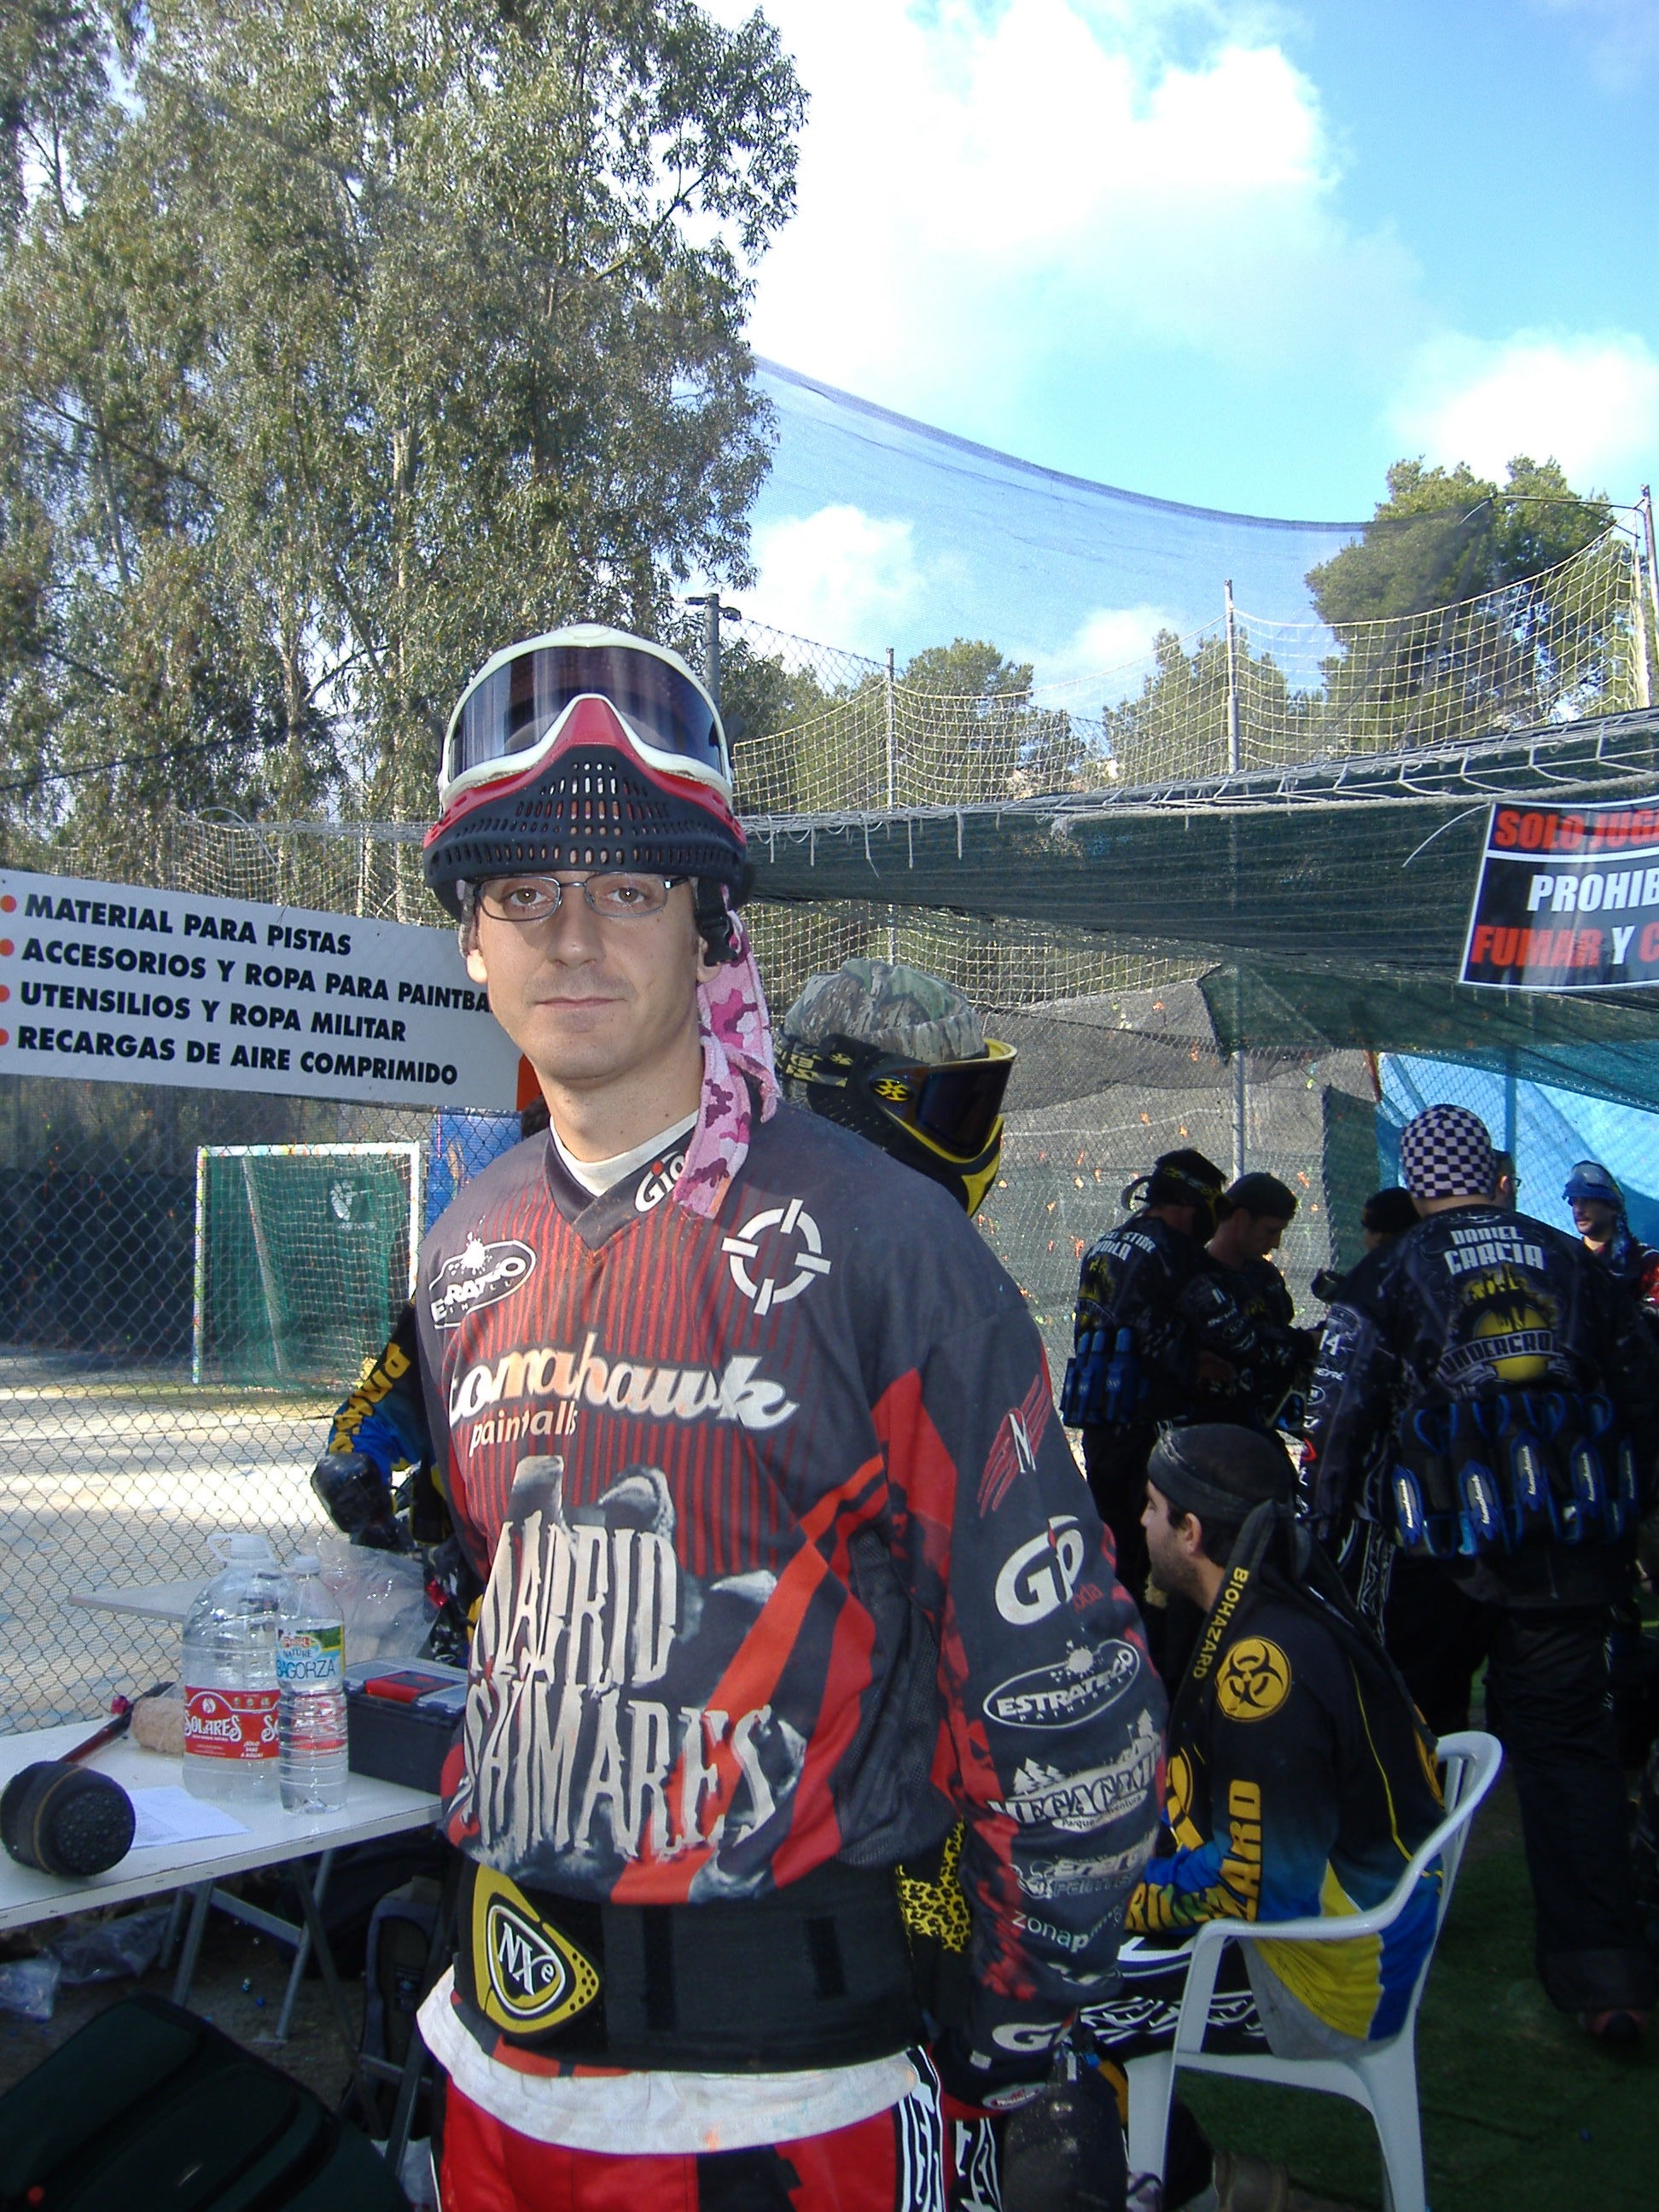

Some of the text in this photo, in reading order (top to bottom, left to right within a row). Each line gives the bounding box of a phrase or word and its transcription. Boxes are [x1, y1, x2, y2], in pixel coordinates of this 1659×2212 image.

[1494, 810, 1586, 849] SOLO
[1526, 867, 1659, 912] PROHIB
[24, 894, 352, 956] MATERIAL PARA PISTAS
[1470, 924, 1603, 968] FUMAR
[1611, 925, 1636, 965] Y
[21, 937, 206, 981] ACCESORIOS
[217, 959, 236, 982] Y
[245, 963, 316, 992] ROPA
[325, 973, 389, 1001] PARA
[20, 981, 406, 1043] UTENSILIOS Y ROPA MILITAR
[17, 1025, 458, 1086] RECARGAS DE AIRE COMPRIMIDO
[1450, 1225, 1524, 1245] DANIEL
[1443, 1242, 1545, 1276] GARCIA
[1192, 1565, 1250, 1680] BIOHAZARD
[183, 1709, 242, 1743] SOLARES
